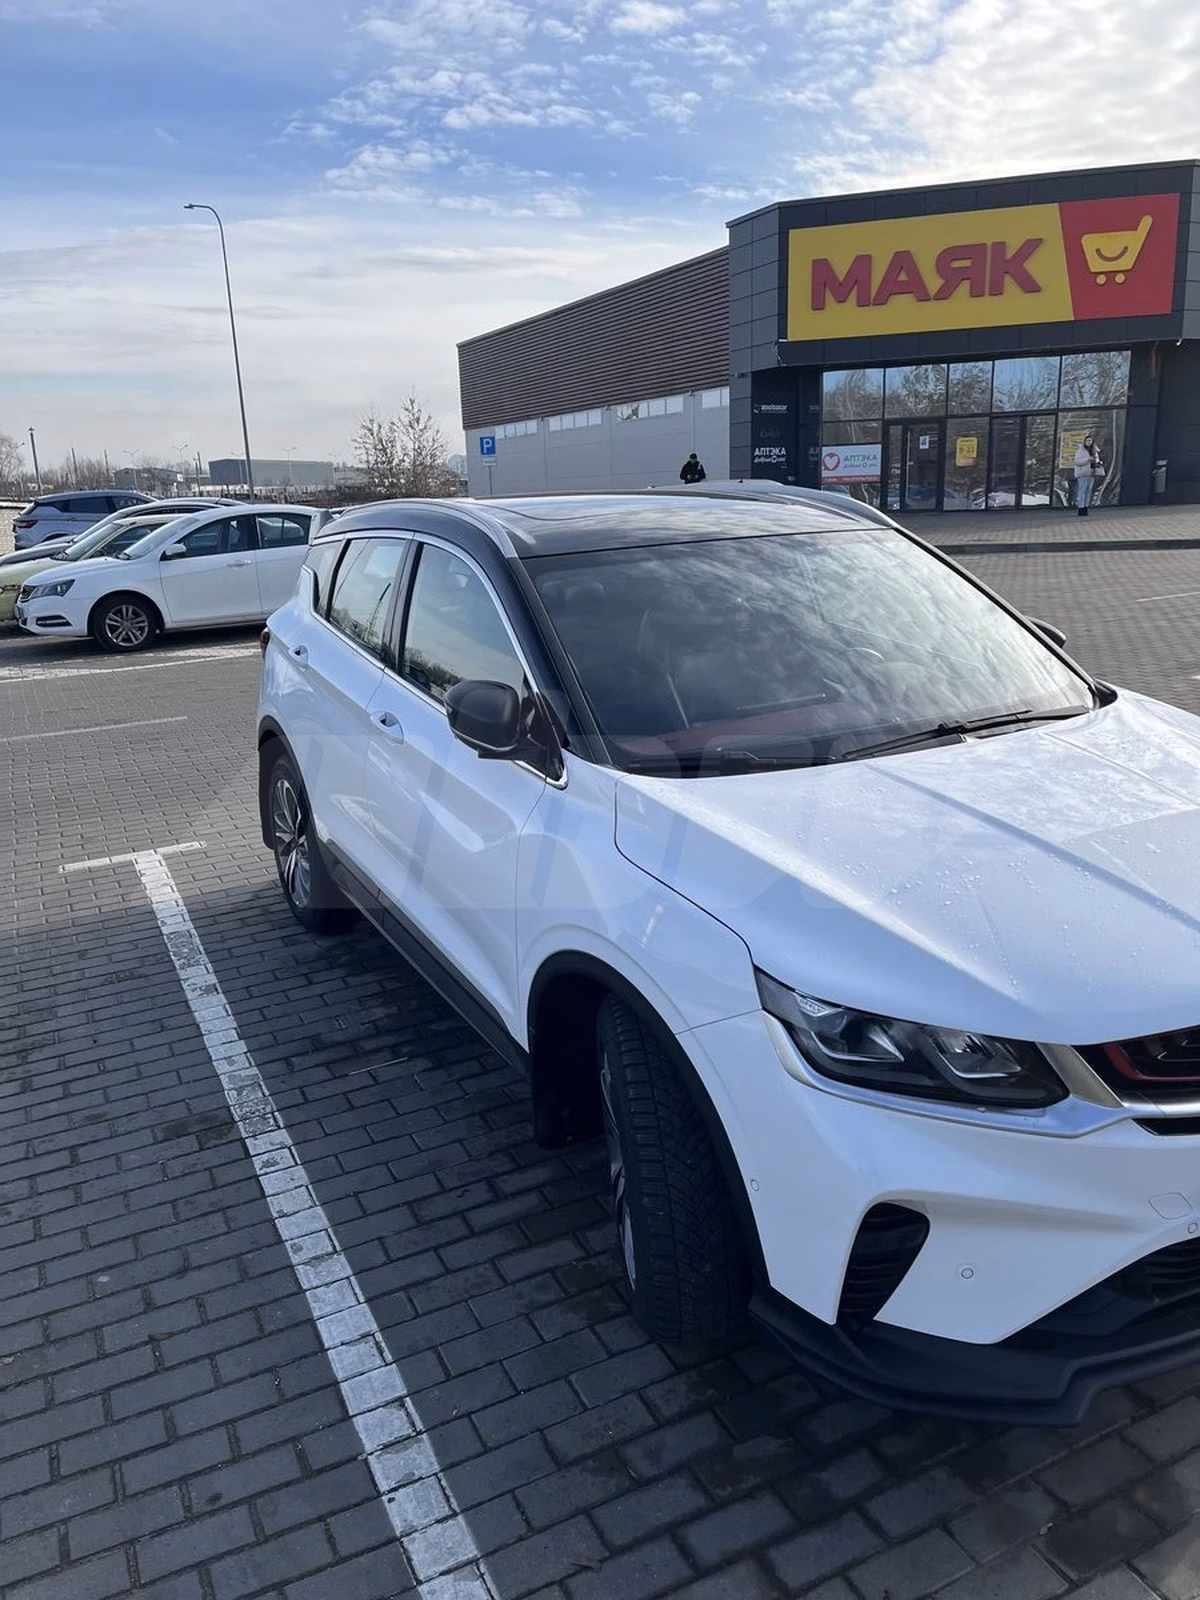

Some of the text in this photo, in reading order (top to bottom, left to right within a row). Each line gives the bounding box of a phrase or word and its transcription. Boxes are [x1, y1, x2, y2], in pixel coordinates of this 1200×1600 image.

[811, 238, 1043, 310] МАЯК
[483, 438, 492, 454] P
[753, 447, 787, 456] АПТЭКА
[843, 454, 878, 462] АПТЭКА
